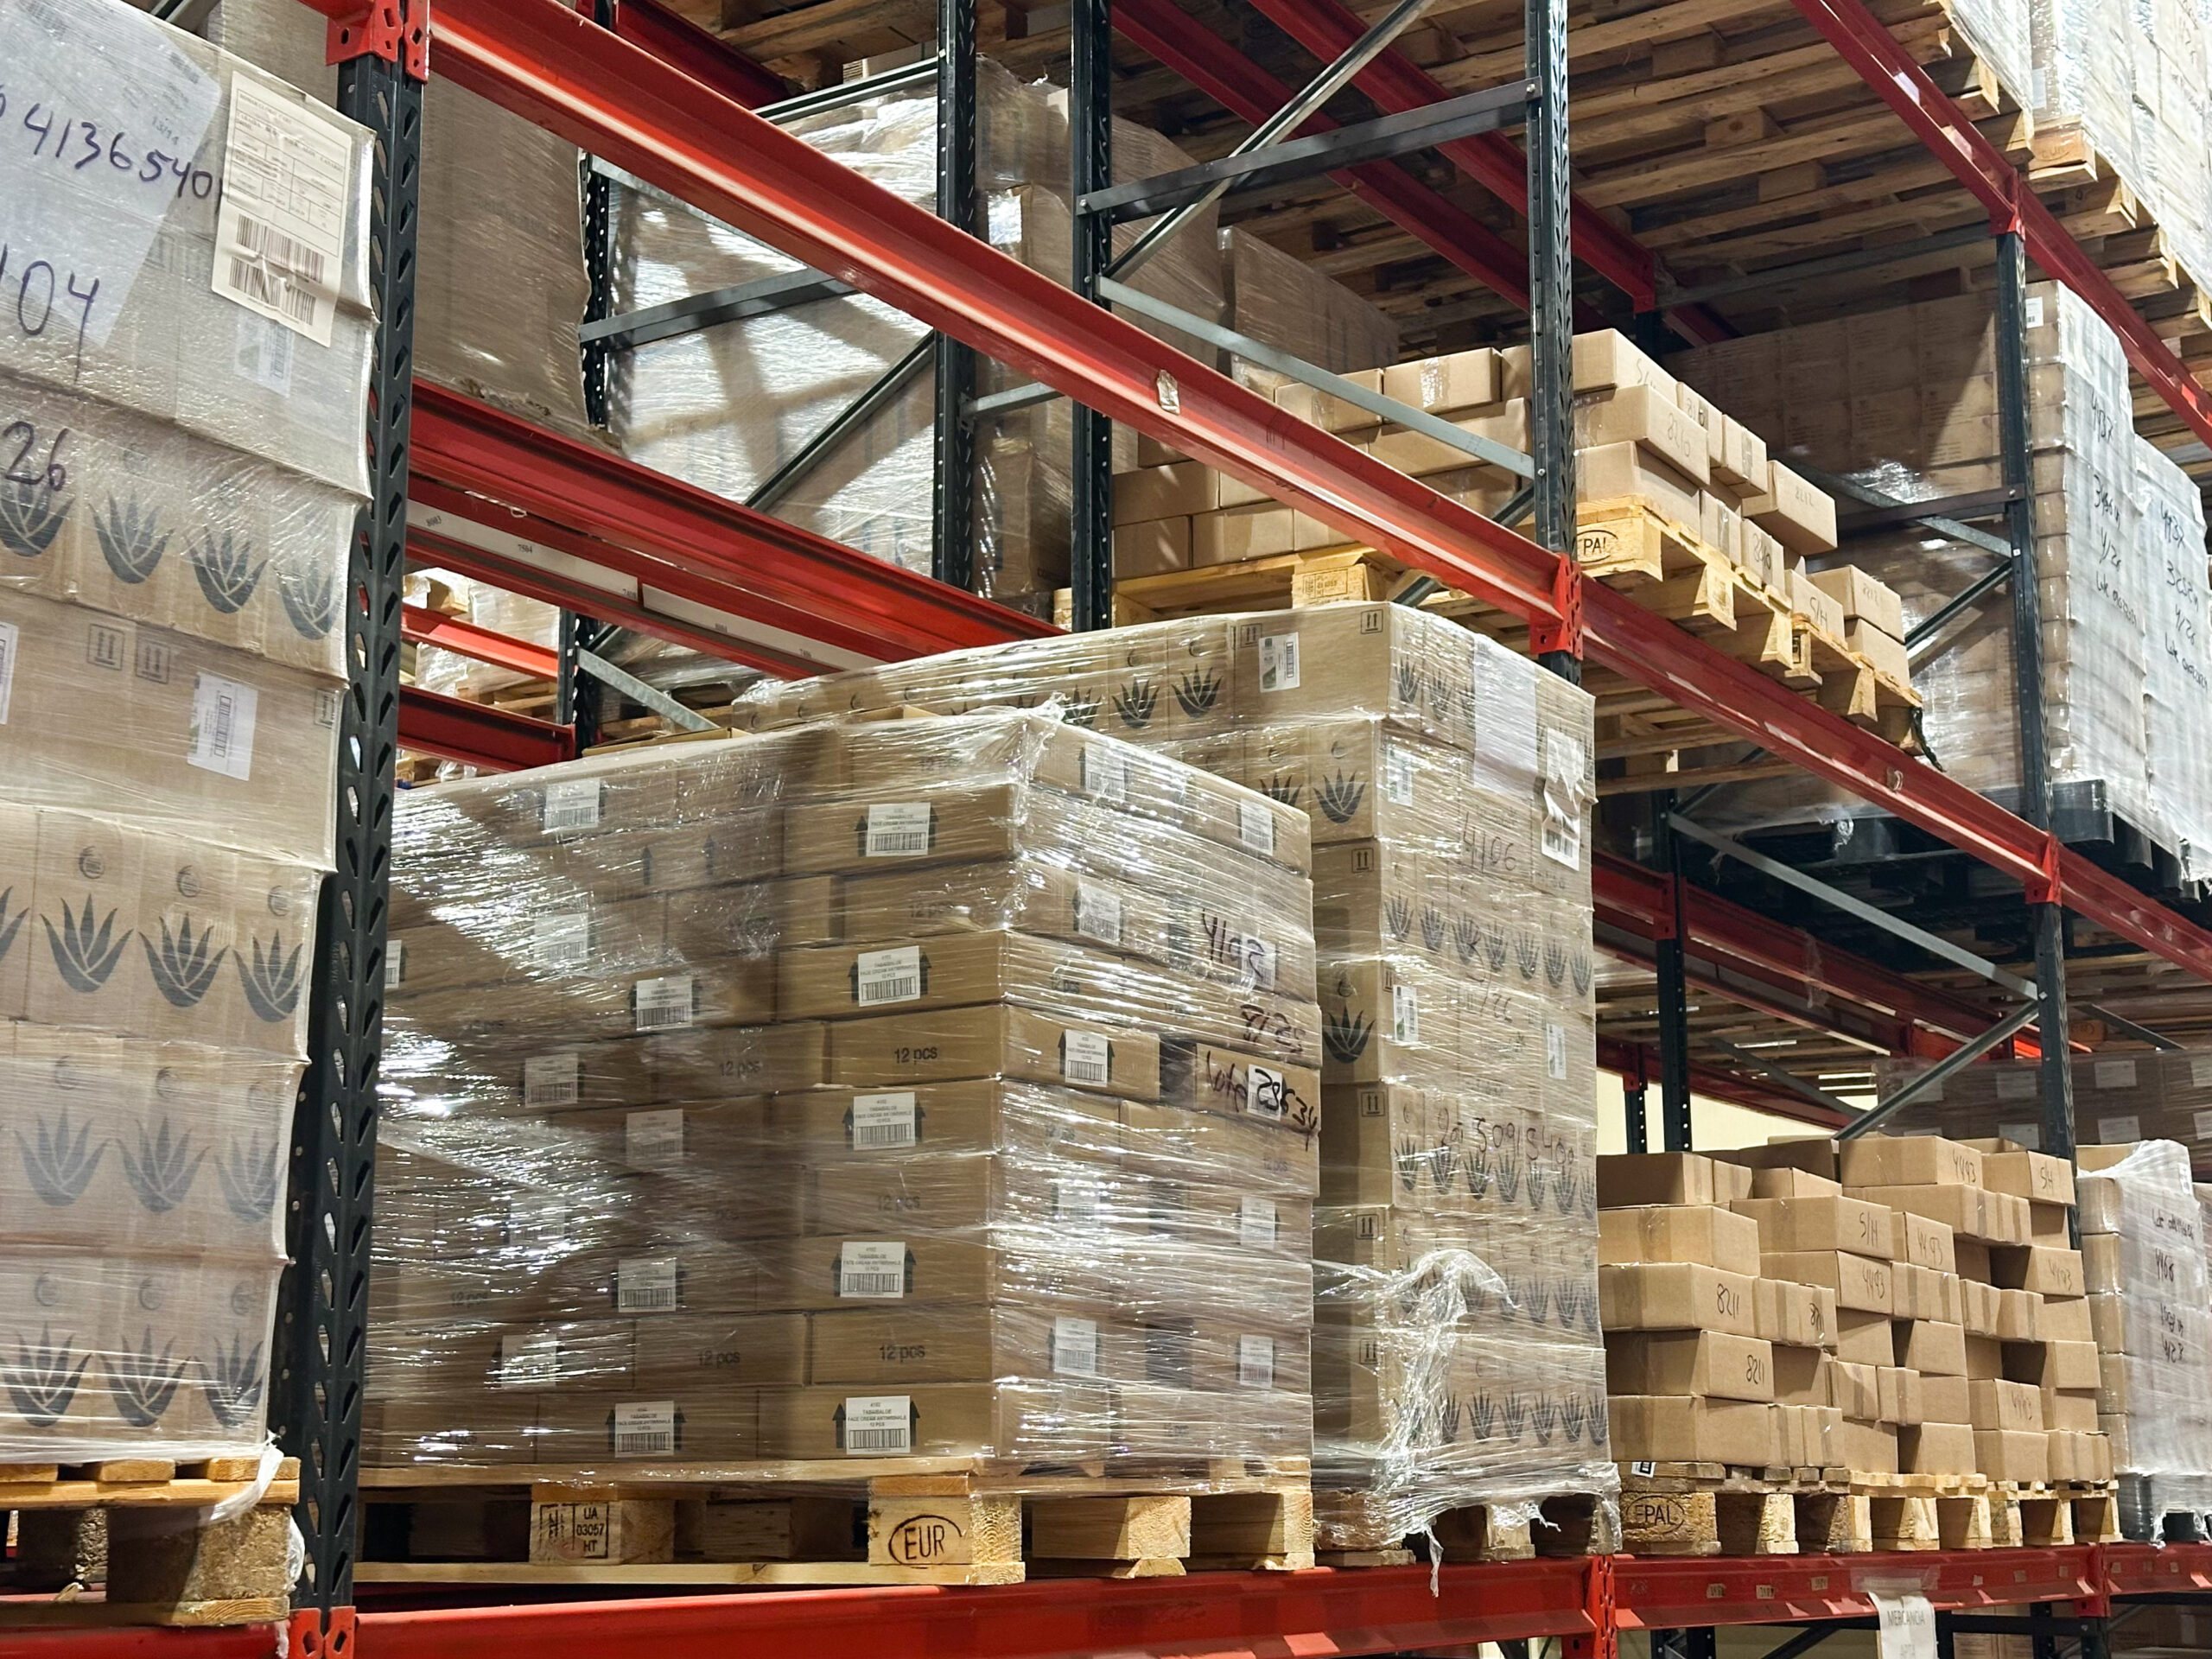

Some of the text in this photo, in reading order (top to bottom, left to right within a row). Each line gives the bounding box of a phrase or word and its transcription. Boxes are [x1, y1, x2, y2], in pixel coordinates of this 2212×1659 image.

[893, 1046, 938, 1065] 12 pcs
[1716, 1282, 1740, 1320] 8211
[716, 1351, 741, 1370] pcs
[879, 1344, 925, 1363] 12 pcs
[583, 1507, 599, 1520] UA
[576, 1523, 605, 1536] 03057
[583, 1540, 598, 1552] HT
[904, 1524, 945, 1560] EUR
